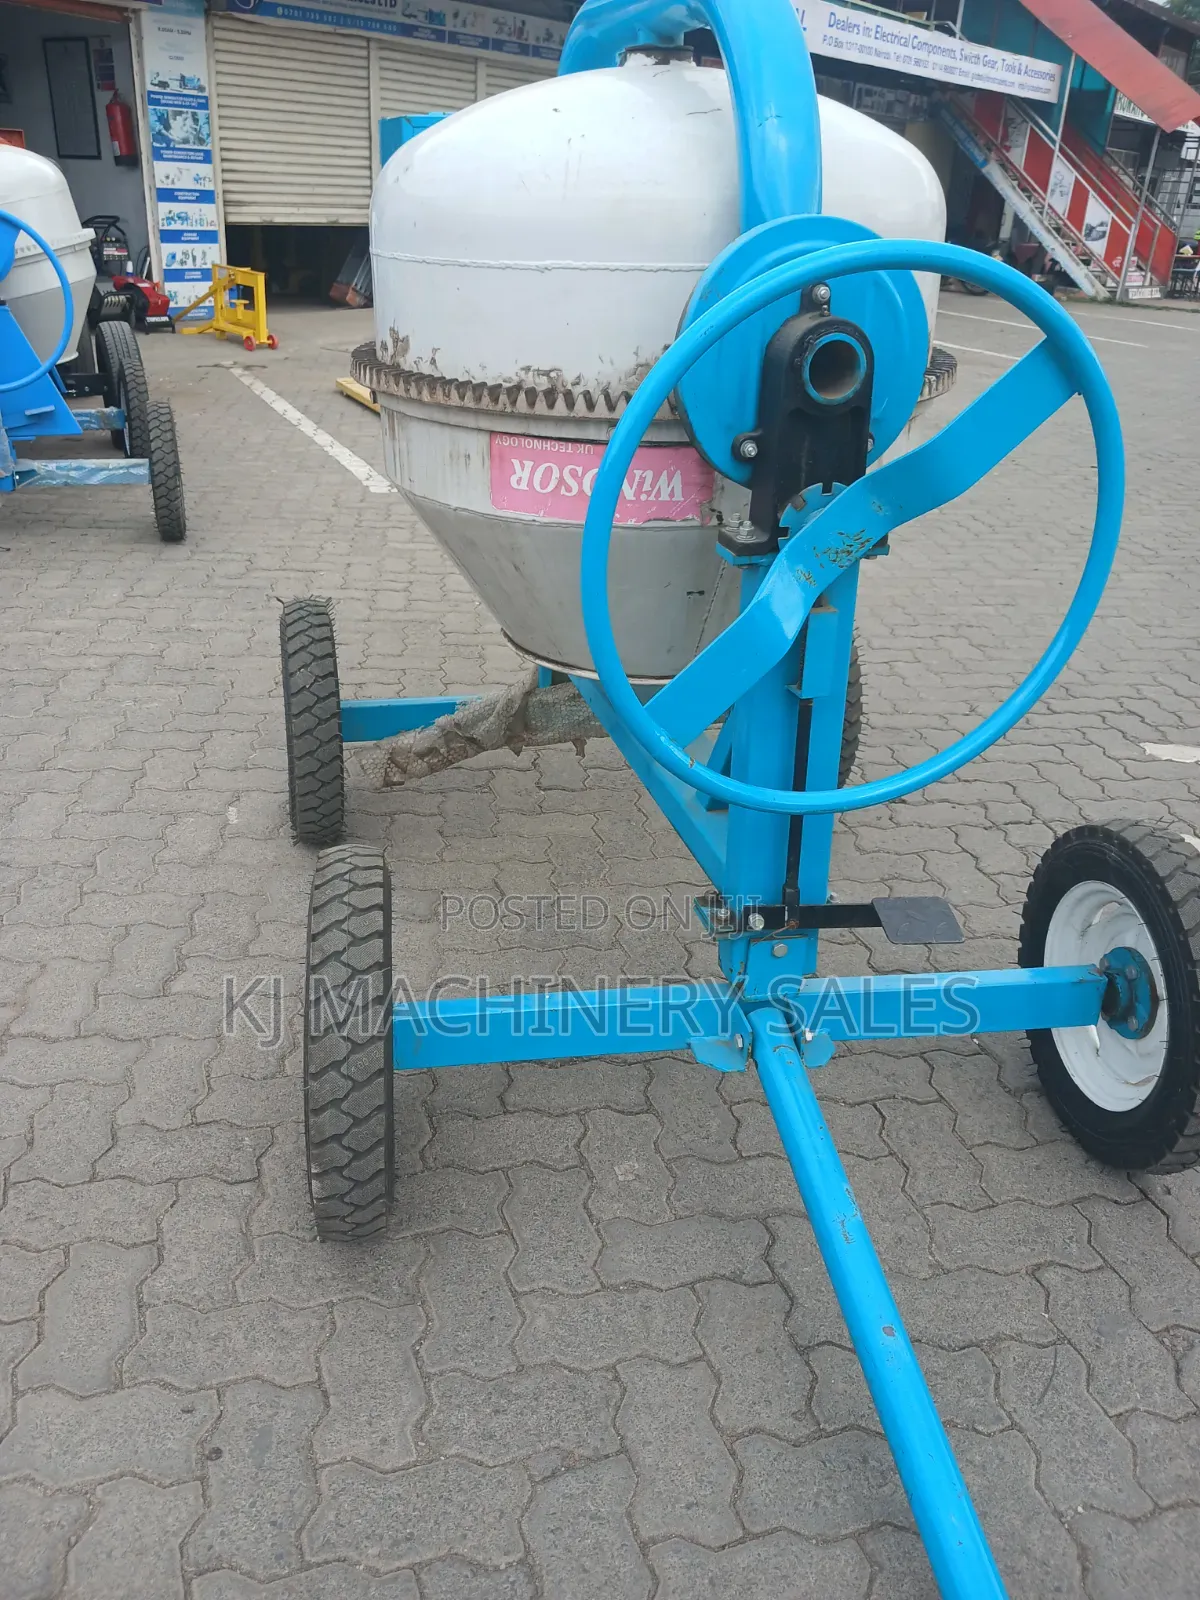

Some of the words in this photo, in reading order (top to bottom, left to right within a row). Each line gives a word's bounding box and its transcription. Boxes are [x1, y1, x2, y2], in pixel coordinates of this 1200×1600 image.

[828, 11, 860, 36] Dealers
[862, 21, 873, 38] in:
[874, 25, 911, 49] Electrical
[911, 35, 957, 61] Components,
[982, 54, 999, 72] Gear,
[1001, 58, 1017, 75] Tools
[1017, 63, 1023, 76] &
[1023, 65, 1056, 82] Accessories
[495, 434, 574, 454] TECHNOLOGY
[576, 443, 594, 455] UK
